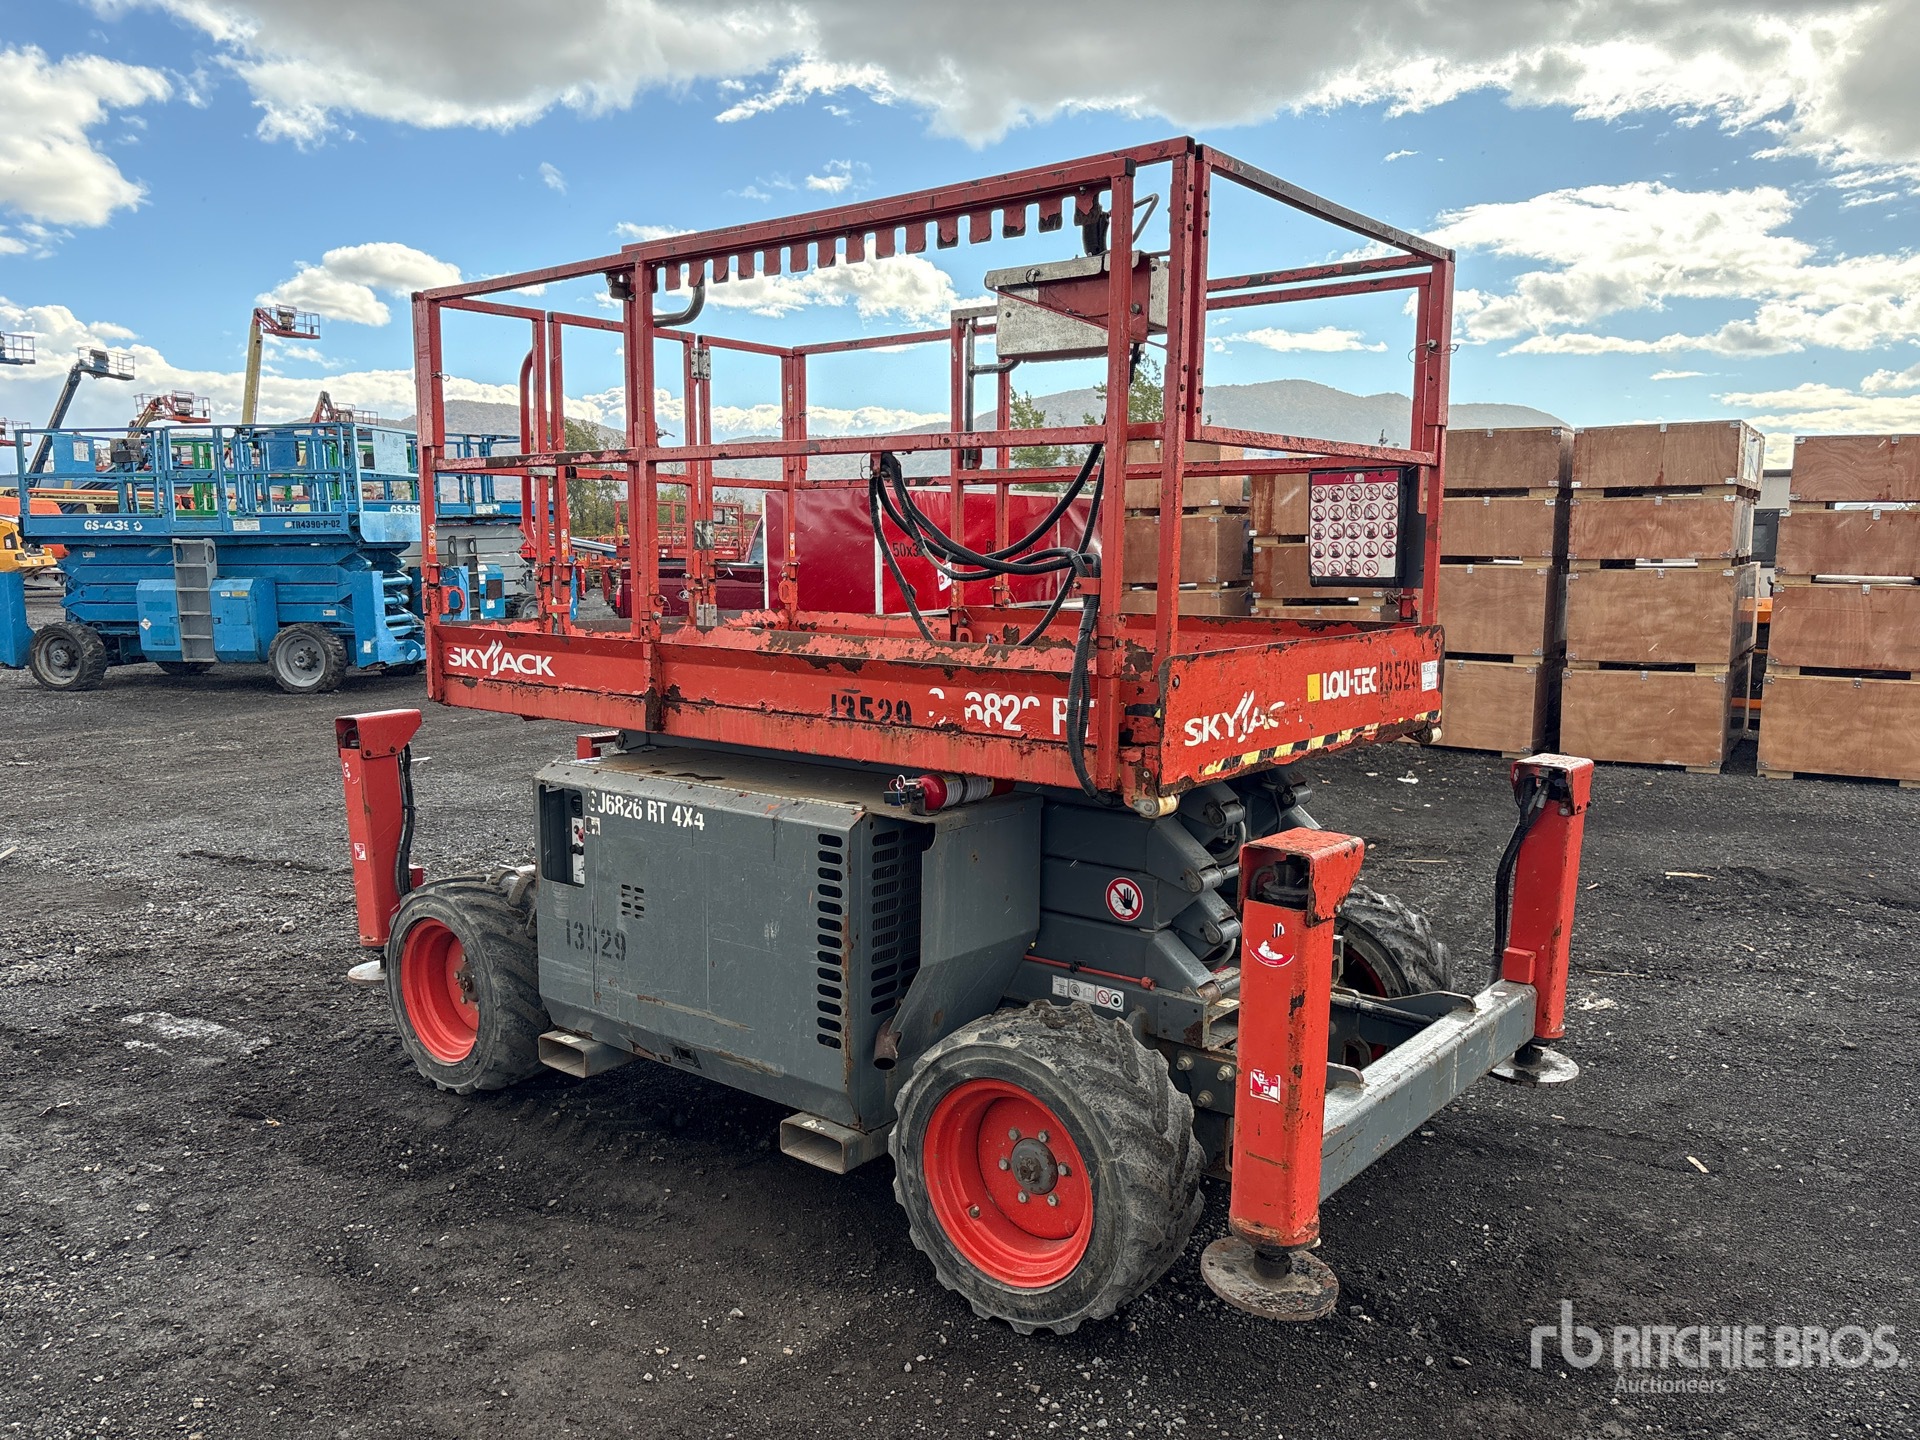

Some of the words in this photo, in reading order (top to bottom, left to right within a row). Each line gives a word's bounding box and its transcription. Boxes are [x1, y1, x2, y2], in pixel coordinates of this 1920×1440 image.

[448, 639, 556, 677] SKYJACK
[1322, 666, 1377, 700] LOU-TEC
[1379, 660, 1420, 692] 13529
[831, 694, 912, 725] 13529
[1184, 690, 1303, 747] SKYJAC
[647, 800, 667, 824] RT
[671, 805, 705, 831] 4X4
